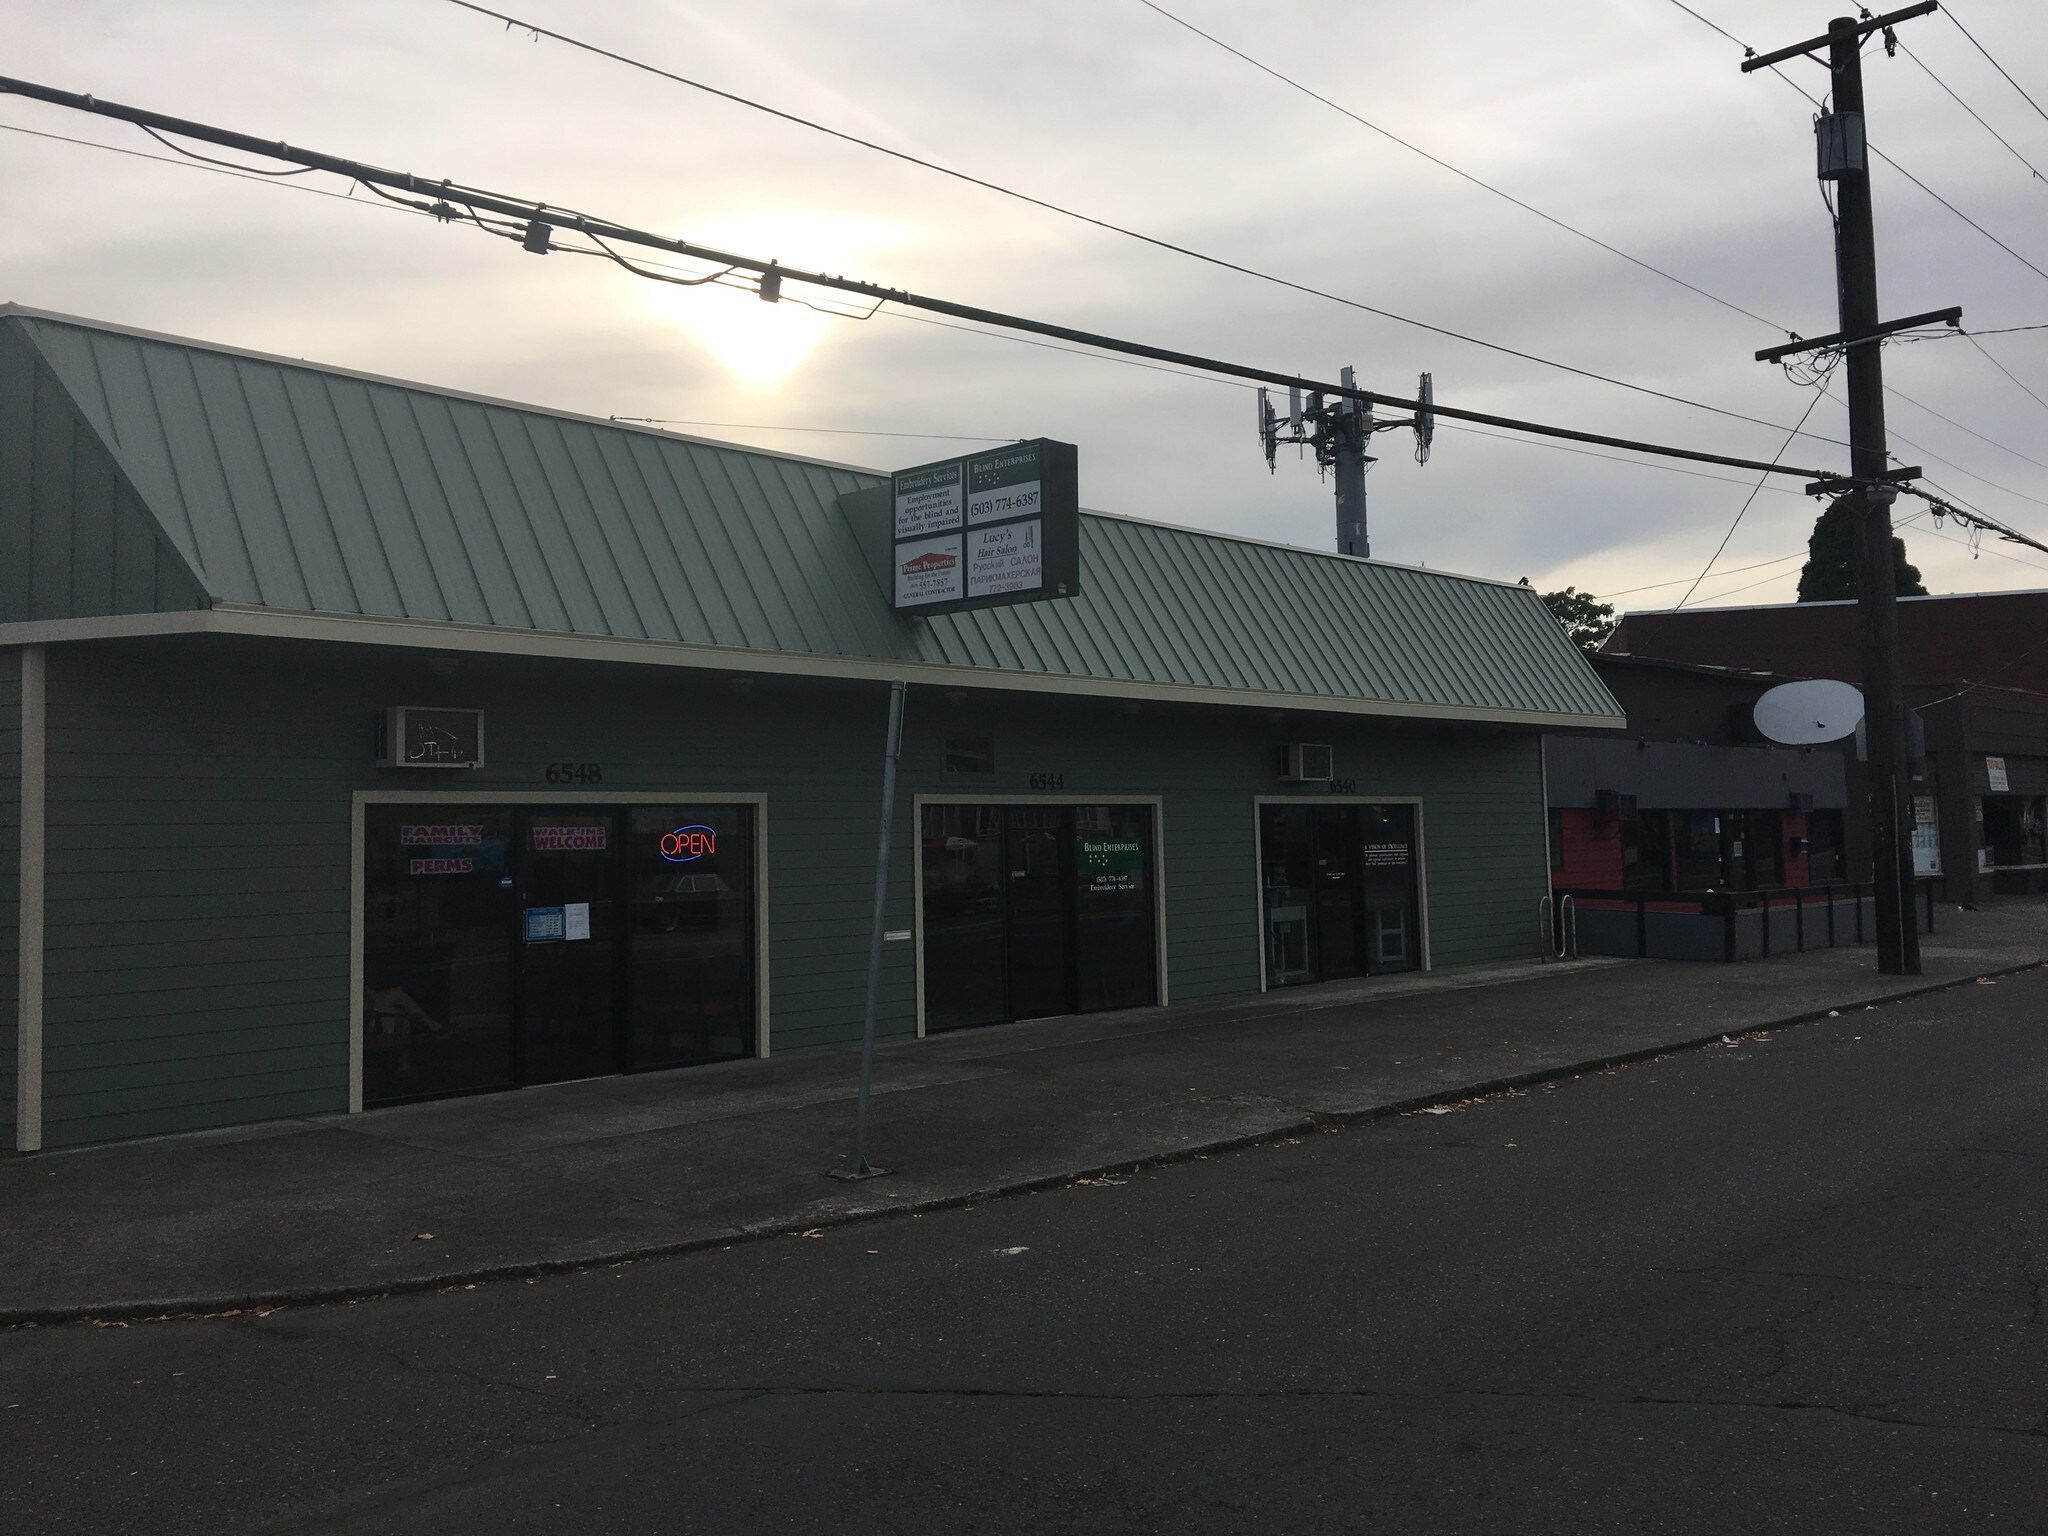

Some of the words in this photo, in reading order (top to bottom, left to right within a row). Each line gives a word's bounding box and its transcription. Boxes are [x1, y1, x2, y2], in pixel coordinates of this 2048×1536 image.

[974, 463, 993, 473] BLIND
[994, 452, 1036, 469] ENTERPRISES
[901, 475, 933, 490] Embroidery
[934, 470, 958, 483] Services
[907, 489, 950, 504] Employment
[905, 499, 952, 515] opportunities
[971, 500, 993, 518] (503)
[996, 491, 1039, 511] 774-6387
[898, 517, 909, 525] for
[911, 513, 922, 522] the
[925, 508, 943, 519] blind
[946, 506, 959, 515] and
[898, 522, 926, 534] visually
[928, 515, 960, 529] impaired
[983, 529, 1012, 544] Lucy's
[977, 548, 995, 558] Hair
[996, 544, 1018, 555] Salon
[903, 563, 922, 573] Prime
[923, 557, 955, 570] Properties
[1010, 554, 1039, 566] САЛОН
[919, 577, 948, 590] 557-7857
[970, 567, 1041, 585] ПАРИКМАХЕРСКАЯ
[903, 591, 924, 599] GENERAL
[925, 586, 956, 597] CONTRACTOR
[545, 763, 602, 785] 6548
[1029, 773, 1065, 790] 6544
[1330, 780, 1356, 793] 6540
[402, 827, 481, 836] FAMILY
[533, 828, 604, 836] WALK-INS
[402, 836, 481, 844] HAIRCUTS
[535, 836, 605, 849] WELCOME
[660, 833, 717, 855] OPEN
[1084, 842, 1102, 852] BLIND
[1103, 842, 1139, 851] ENTERPRISES
[412, 860, 472, 873] PERMS
